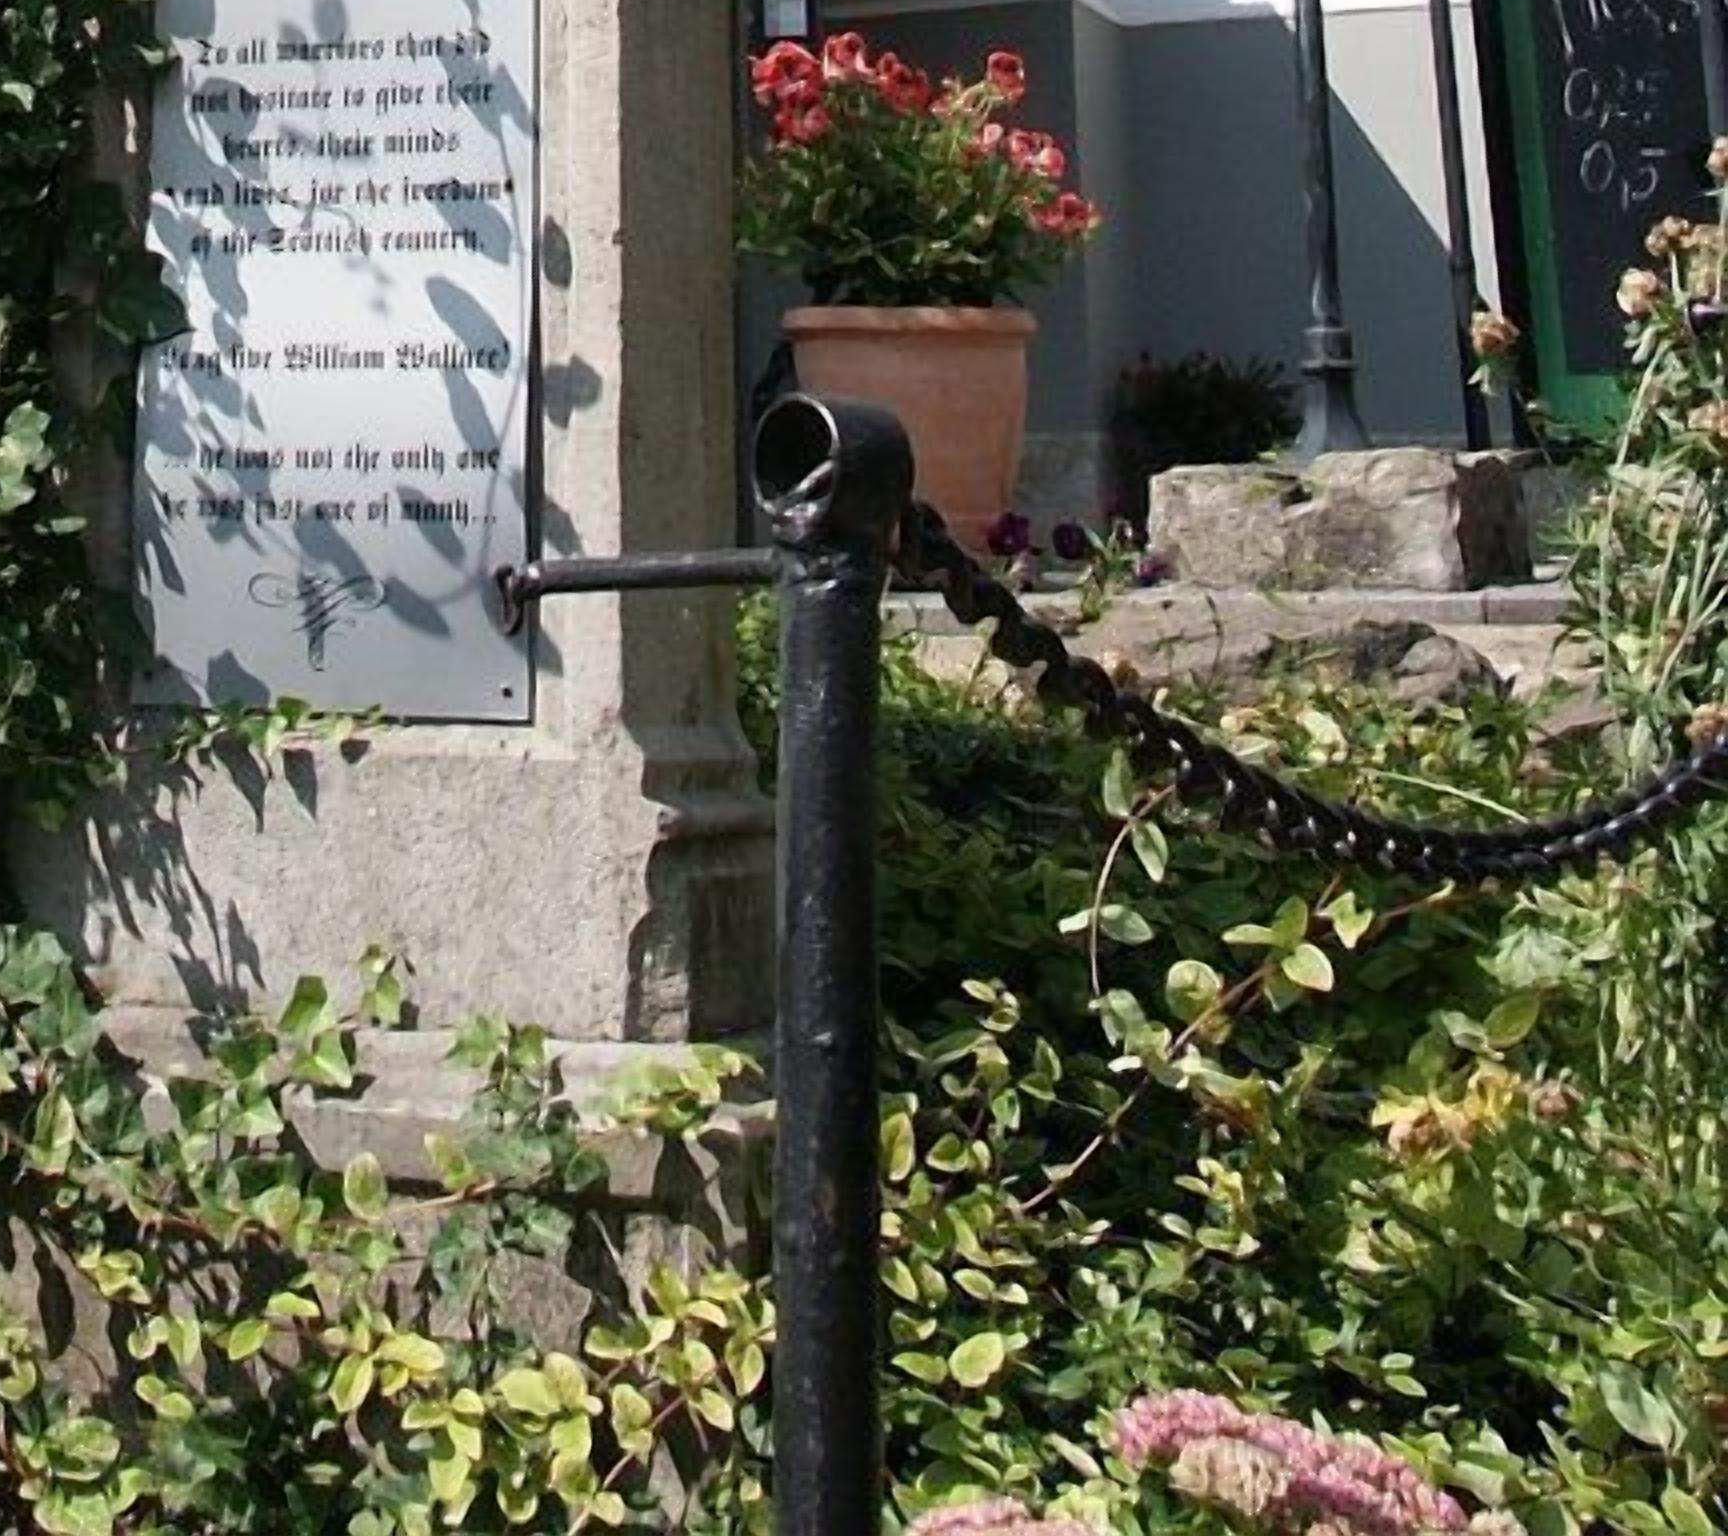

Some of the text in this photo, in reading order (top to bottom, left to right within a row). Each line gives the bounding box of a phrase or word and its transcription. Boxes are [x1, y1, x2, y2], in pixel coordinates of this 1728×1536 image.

[236, 36, 266, 65] all
[343, 85, 365, 109] to
[375, 81, 424, 116] give
[231, 343, 273, 369] live
[283, 341, 385, 372] William
[235, 446, 285, 470] was
[296, 446, 333, 472] not
